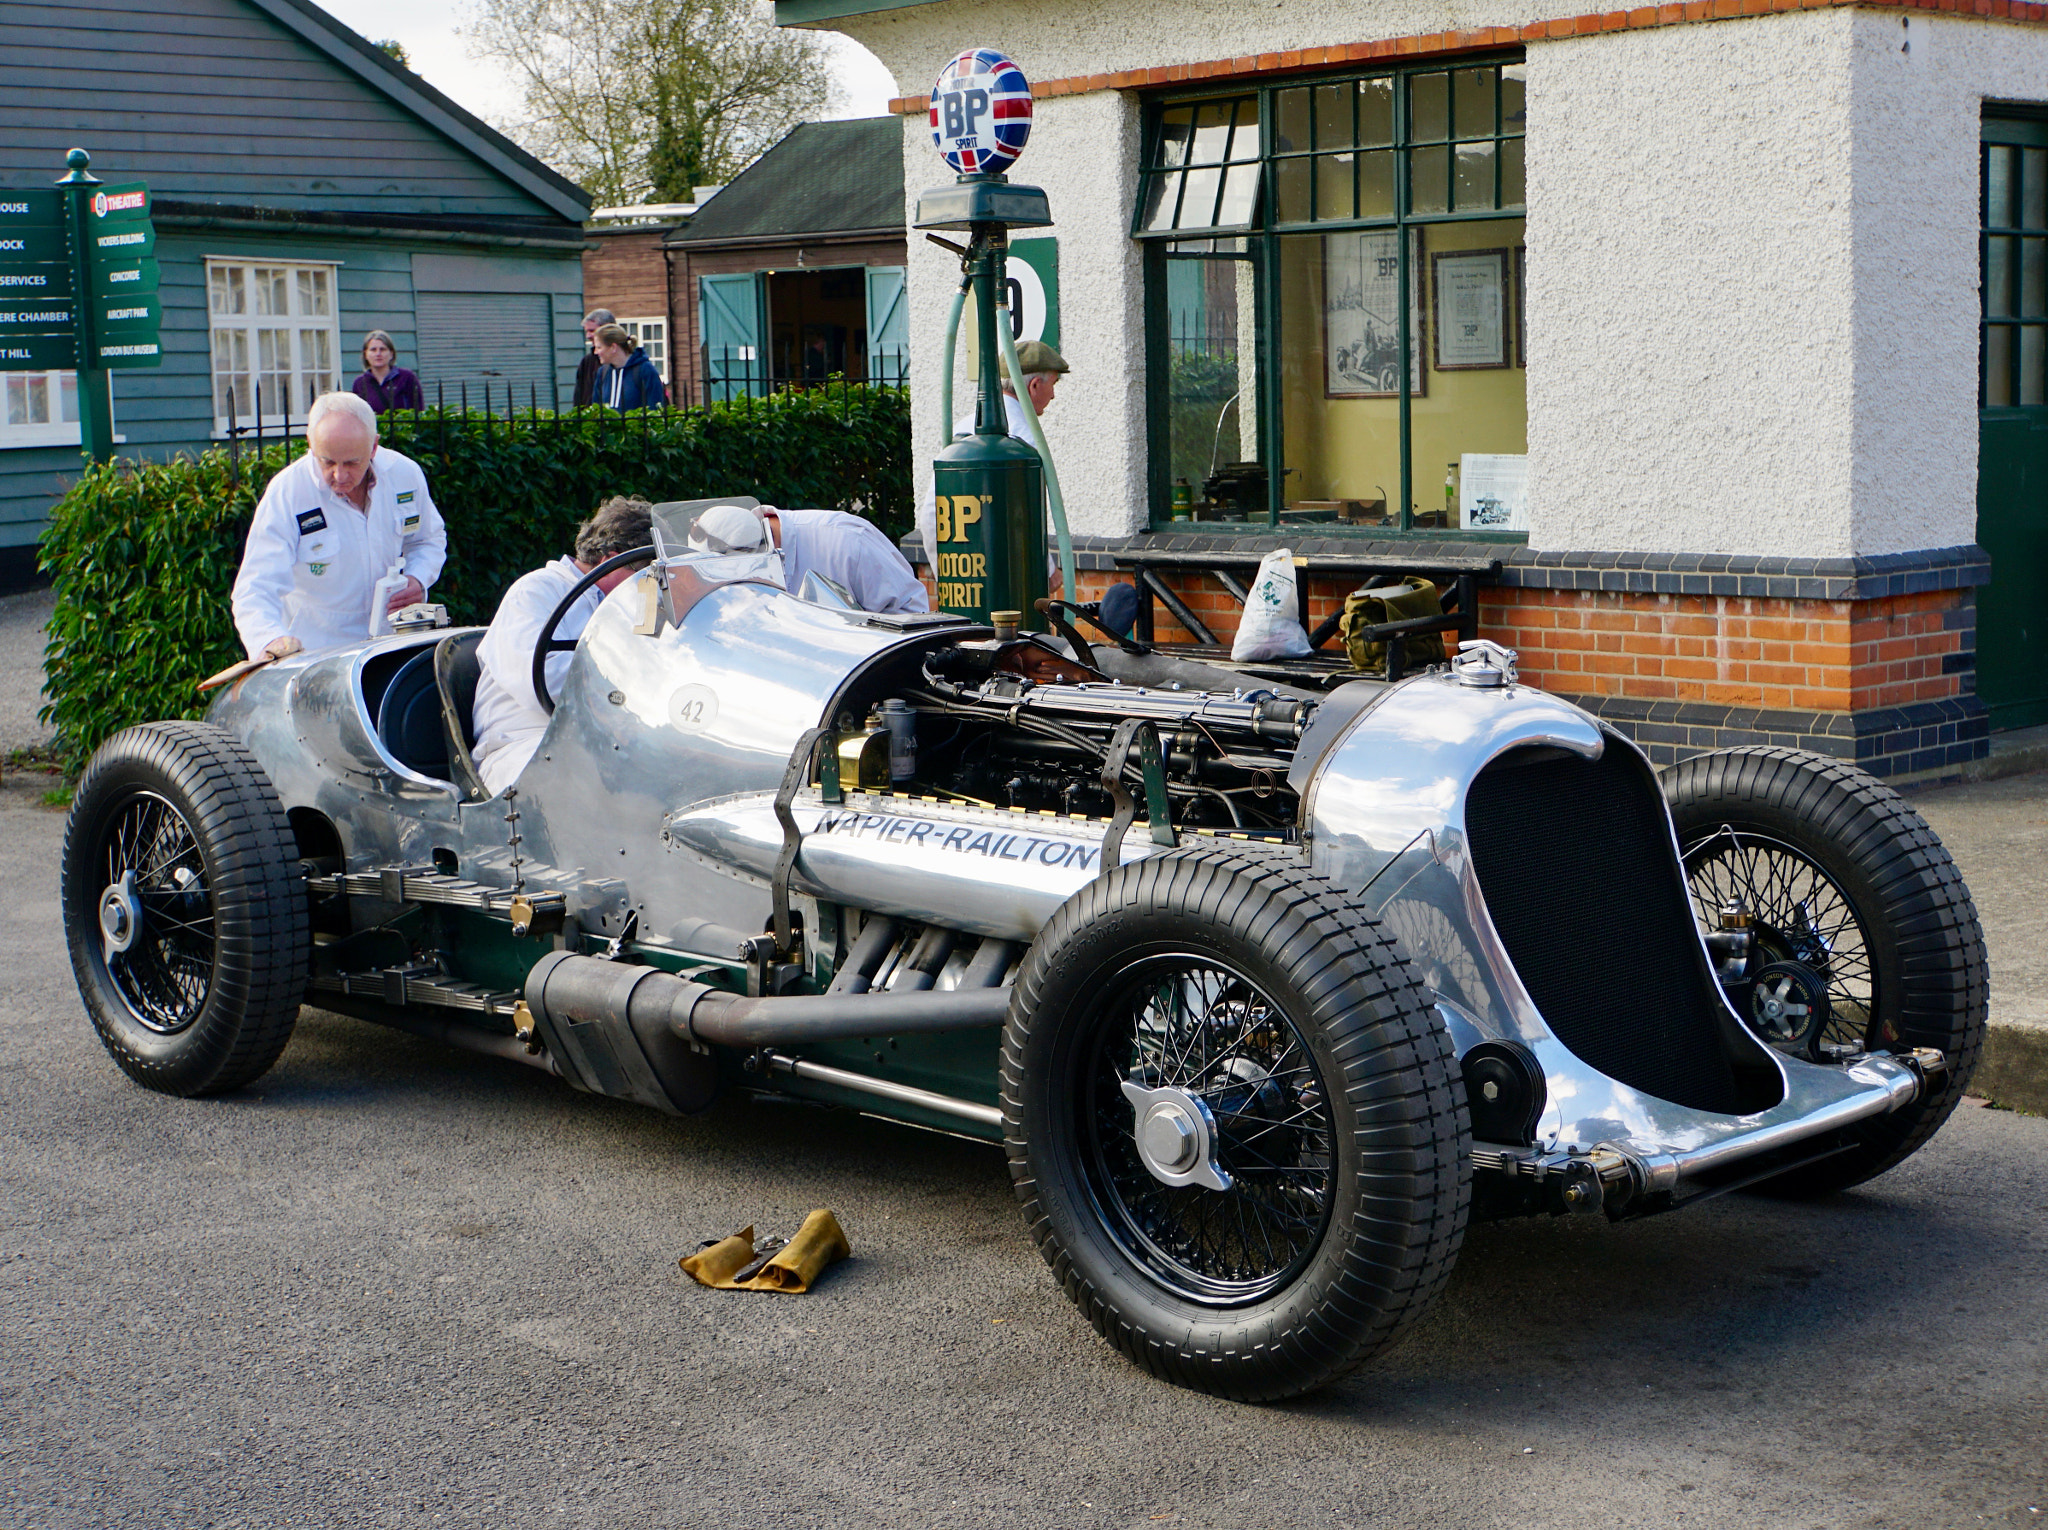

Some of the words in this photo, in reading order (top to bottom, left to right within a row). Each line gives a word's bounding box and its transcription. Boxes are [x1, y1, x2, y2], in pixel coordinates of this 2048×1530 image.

[955, 137, 978, 150] SPIRIT
[0, 203, 29, 213] OUSE
[107, 193, 143, 211] THEATRE
[0, 239, 25, 250] OCK
[120, 233, 146, 244] BUILDING
[0, 275, 48, 287] SERVICES
[109, 270, 141, 283] CONCORDE
[18, 312, 69, 322] CHAMBER
[107, 309, 133, 320] AIRCRAFT
[134, 307, 149, 318] PARK
[8, 348, 32, 359] HILL
[100, 346, 122, 357] LONDON
[123, 345, 134, 356] BUS
[134, 344, 159, 355] MUSEUM
[681, 700, 704, 723] 42
[813, 810, 1100, 870] NAPIER-RAILTON
